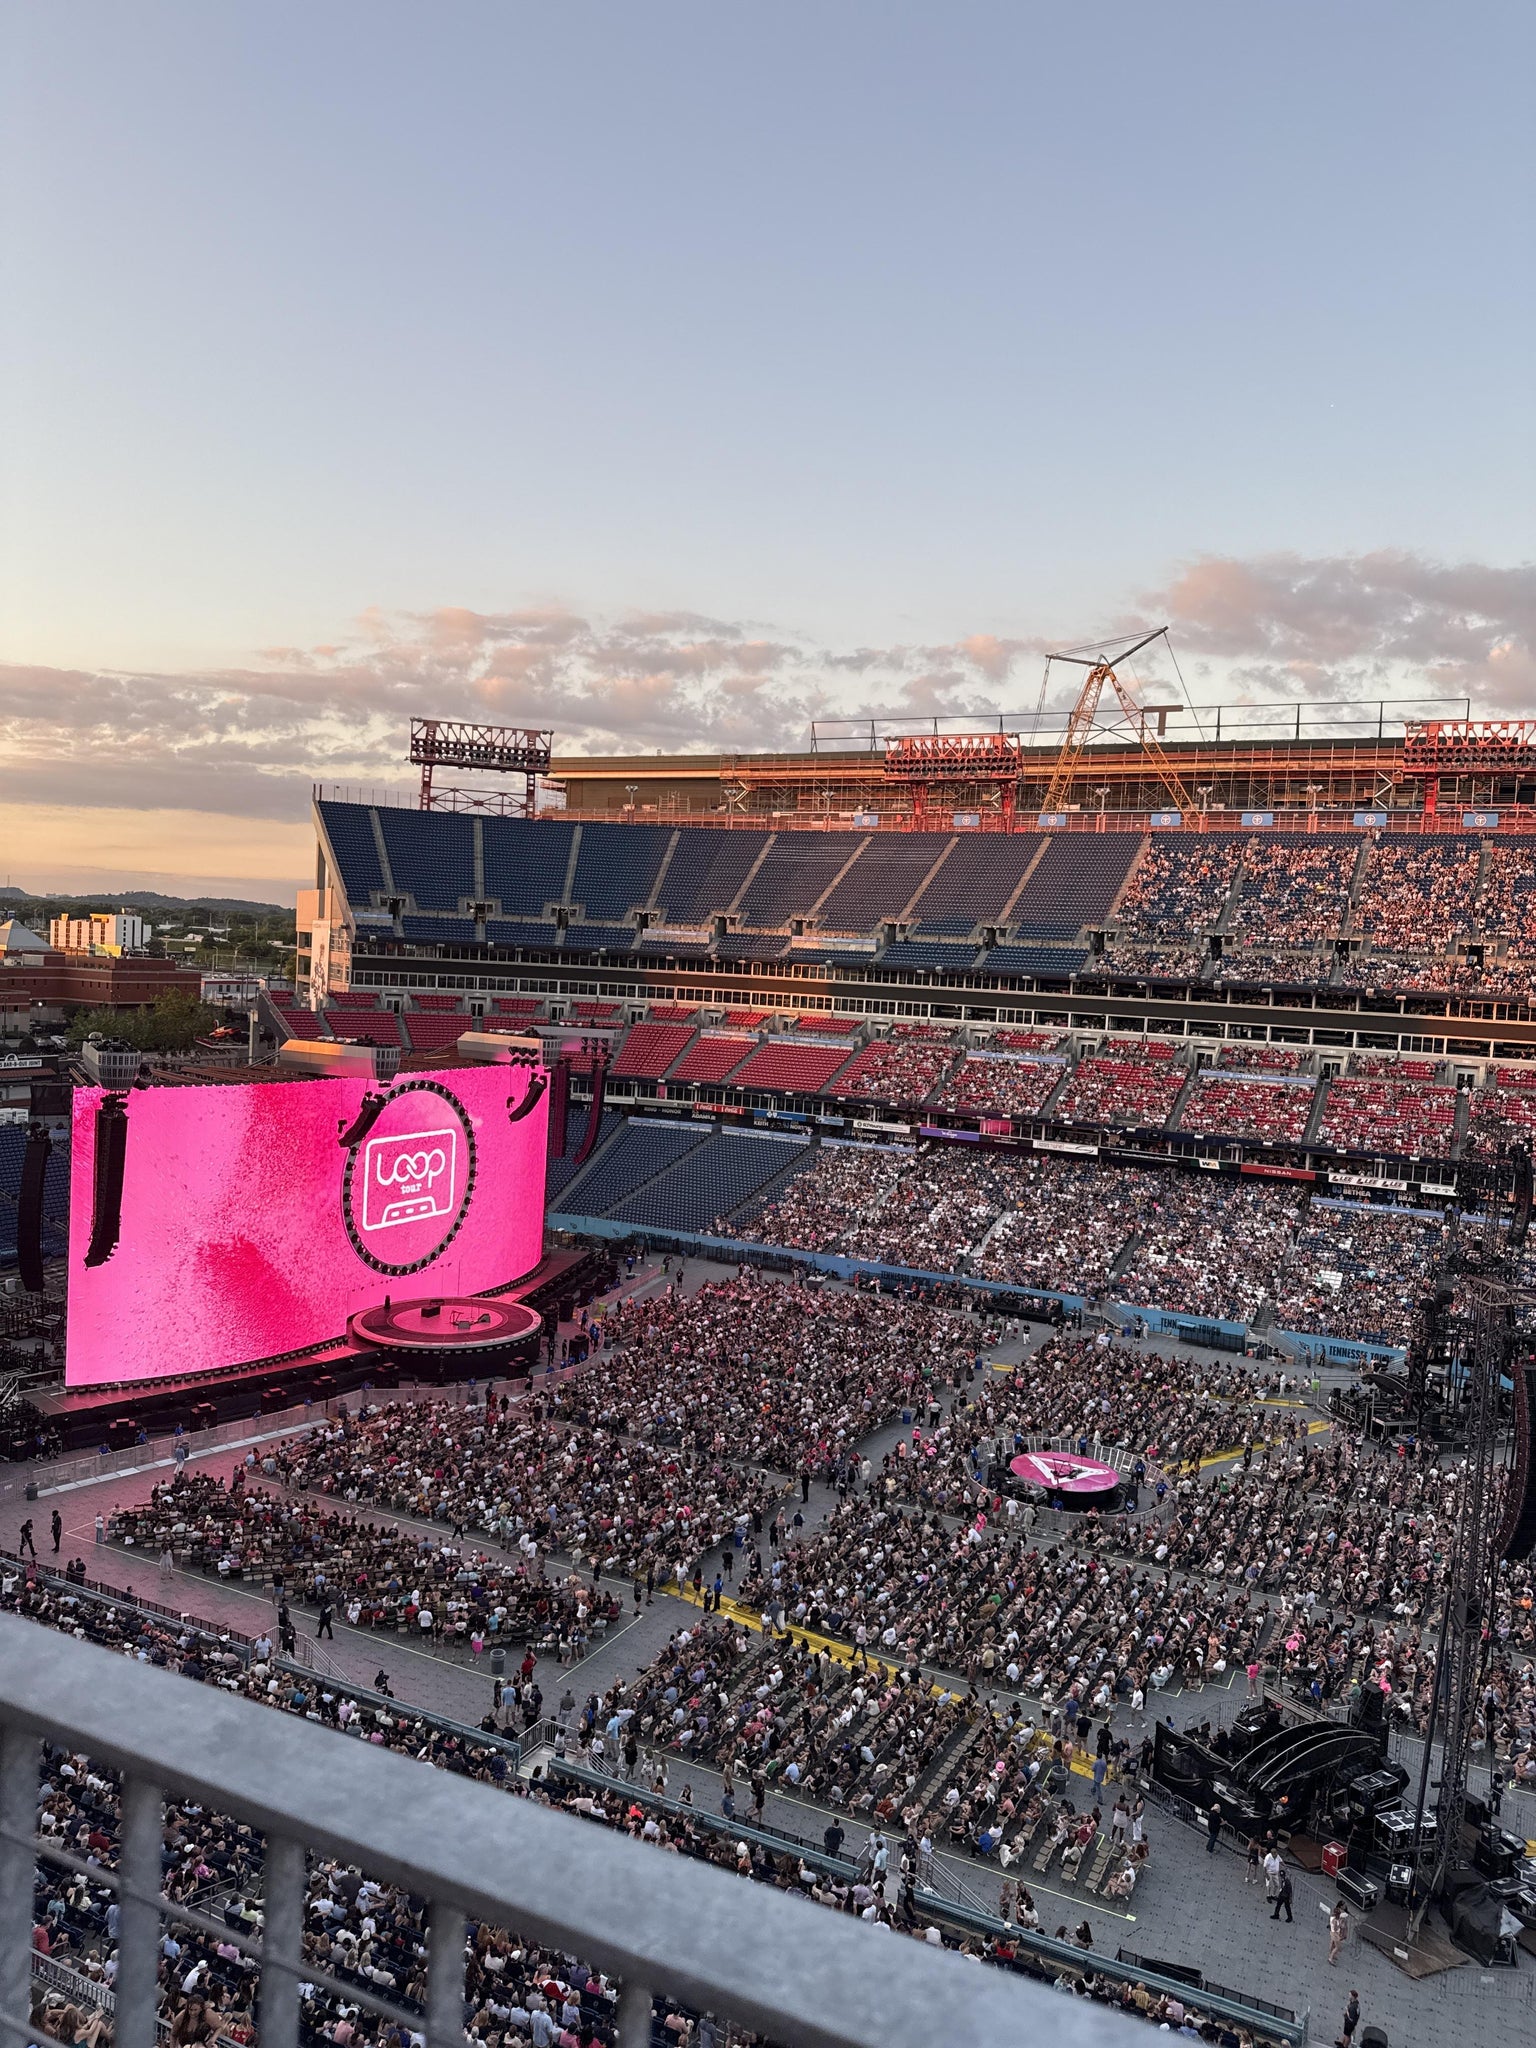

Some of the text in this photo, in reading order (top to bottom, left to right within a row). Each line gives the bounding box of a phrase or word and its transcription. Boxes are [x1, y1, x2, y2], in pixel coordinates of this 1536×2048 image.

[1264, 1168, 1292, 1176] NISSAN
[1343, 1188, 1371, 1197] BETHEA
[1360, 1203, 1383, 1211] TITANS
